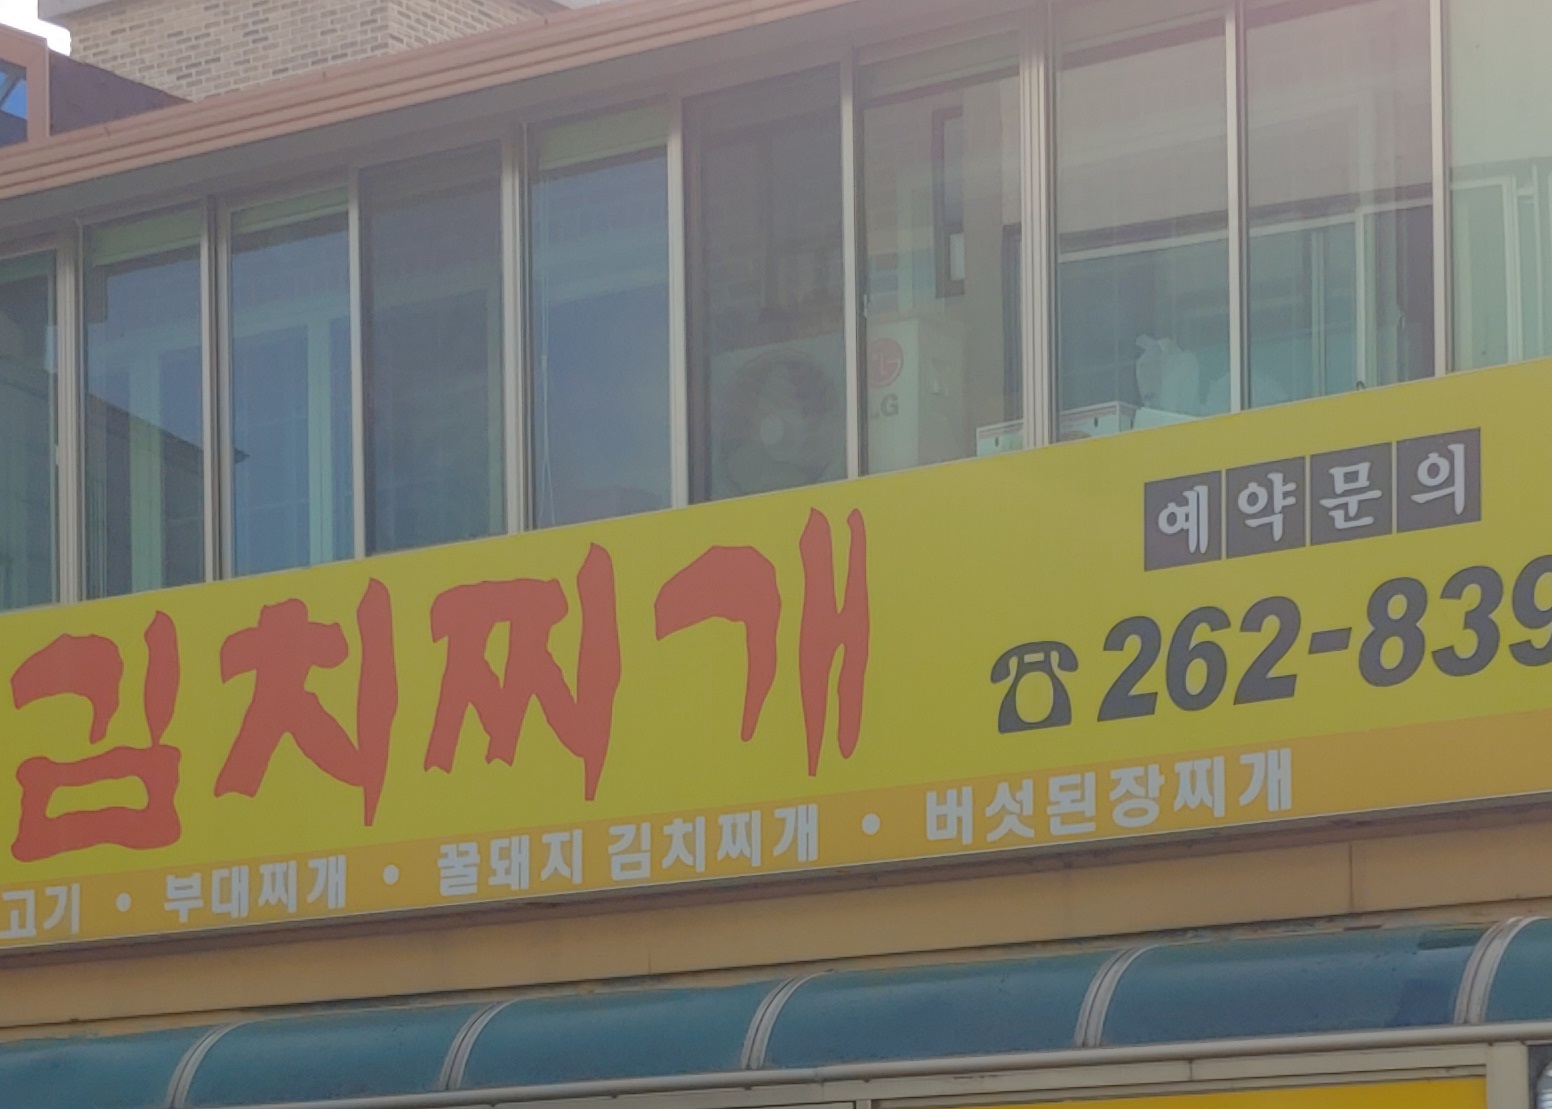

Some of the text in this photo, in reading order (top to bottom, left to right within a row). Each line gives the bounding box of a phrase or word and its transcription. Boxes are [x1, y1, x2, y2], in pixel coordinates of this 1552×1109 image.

[1154, 440, 1470, 558] 예약문의
[9, 507, 870, 863] 김치찌개
[162, 855, 348, 926] 부대찌개
[436, 826, 583, 897] 꿀돼지
[608, 801, 820, 877] 김치찌개
[925, 748, 1295, 847] 버섯된장찌개
